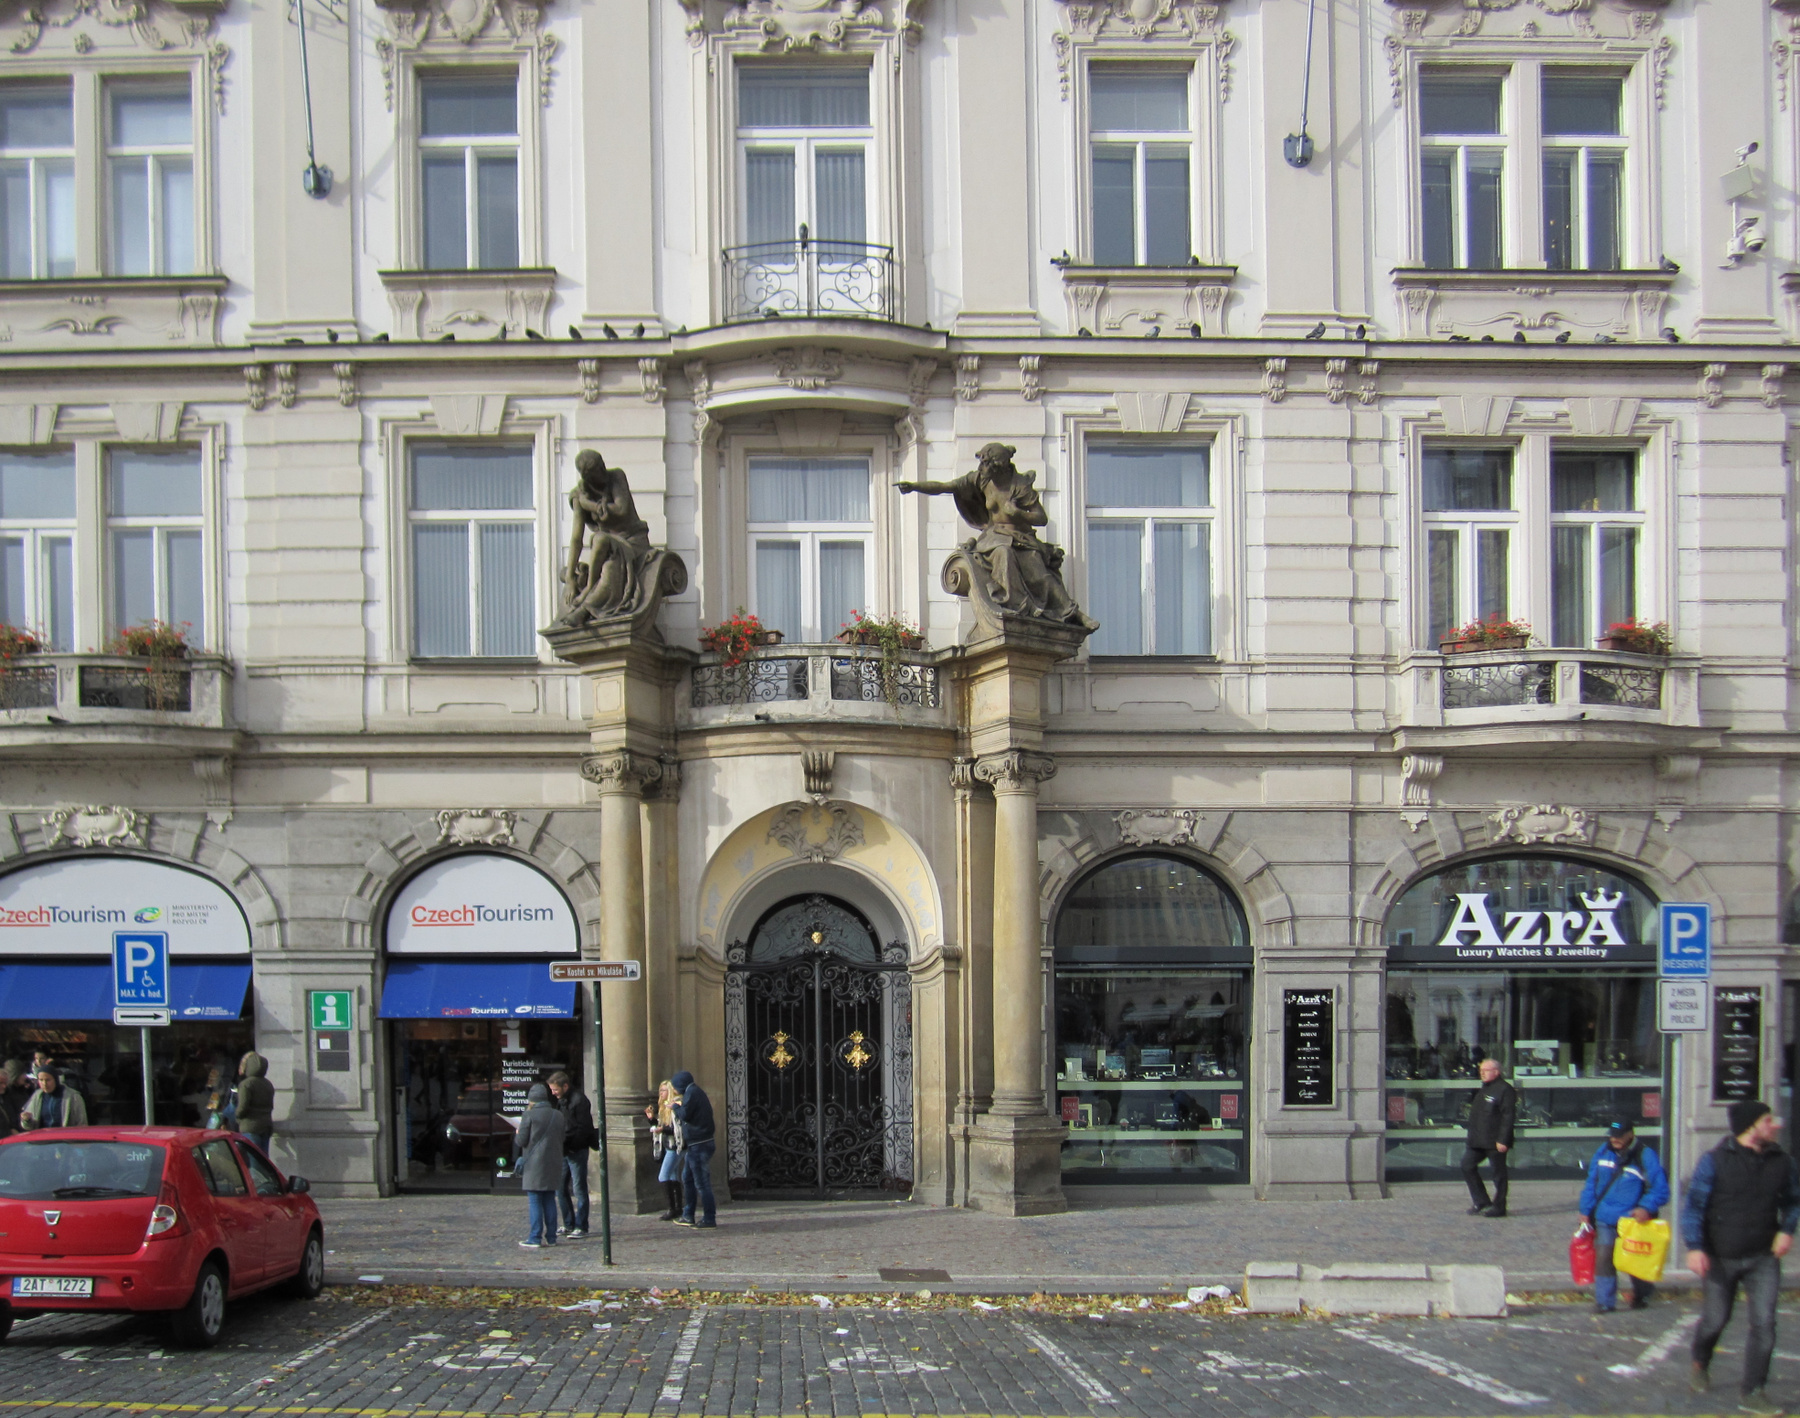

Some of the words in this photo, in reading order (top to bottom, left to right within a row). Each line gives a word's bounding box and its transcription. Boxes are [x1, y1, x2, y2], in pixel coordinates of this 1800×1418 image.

[411, 904, 553, 923] CzechTourism
[1670, 912, 1699, 954] P
[1456, 947, 1493, 958] Luxury
[1496, 947, 1541, 957] Watches
[1544, 947, 1553, 957] &
[1556, 947, 1608, 958] Jewellery
[125, 941, 155, 983] P
[566, 967, 586, 977] Kostel
[597, 966, 623, 976] Mikuláše
[120, 989, 138, 998] MAX.
[140, 989, 146, 998] 4
[148, 989, 163, 998] hod.
[502, 1067, 539, 1075] informační
[24, 1278, 47, 1291] 2AT
[57, 1279, 87, 1292] 1272
